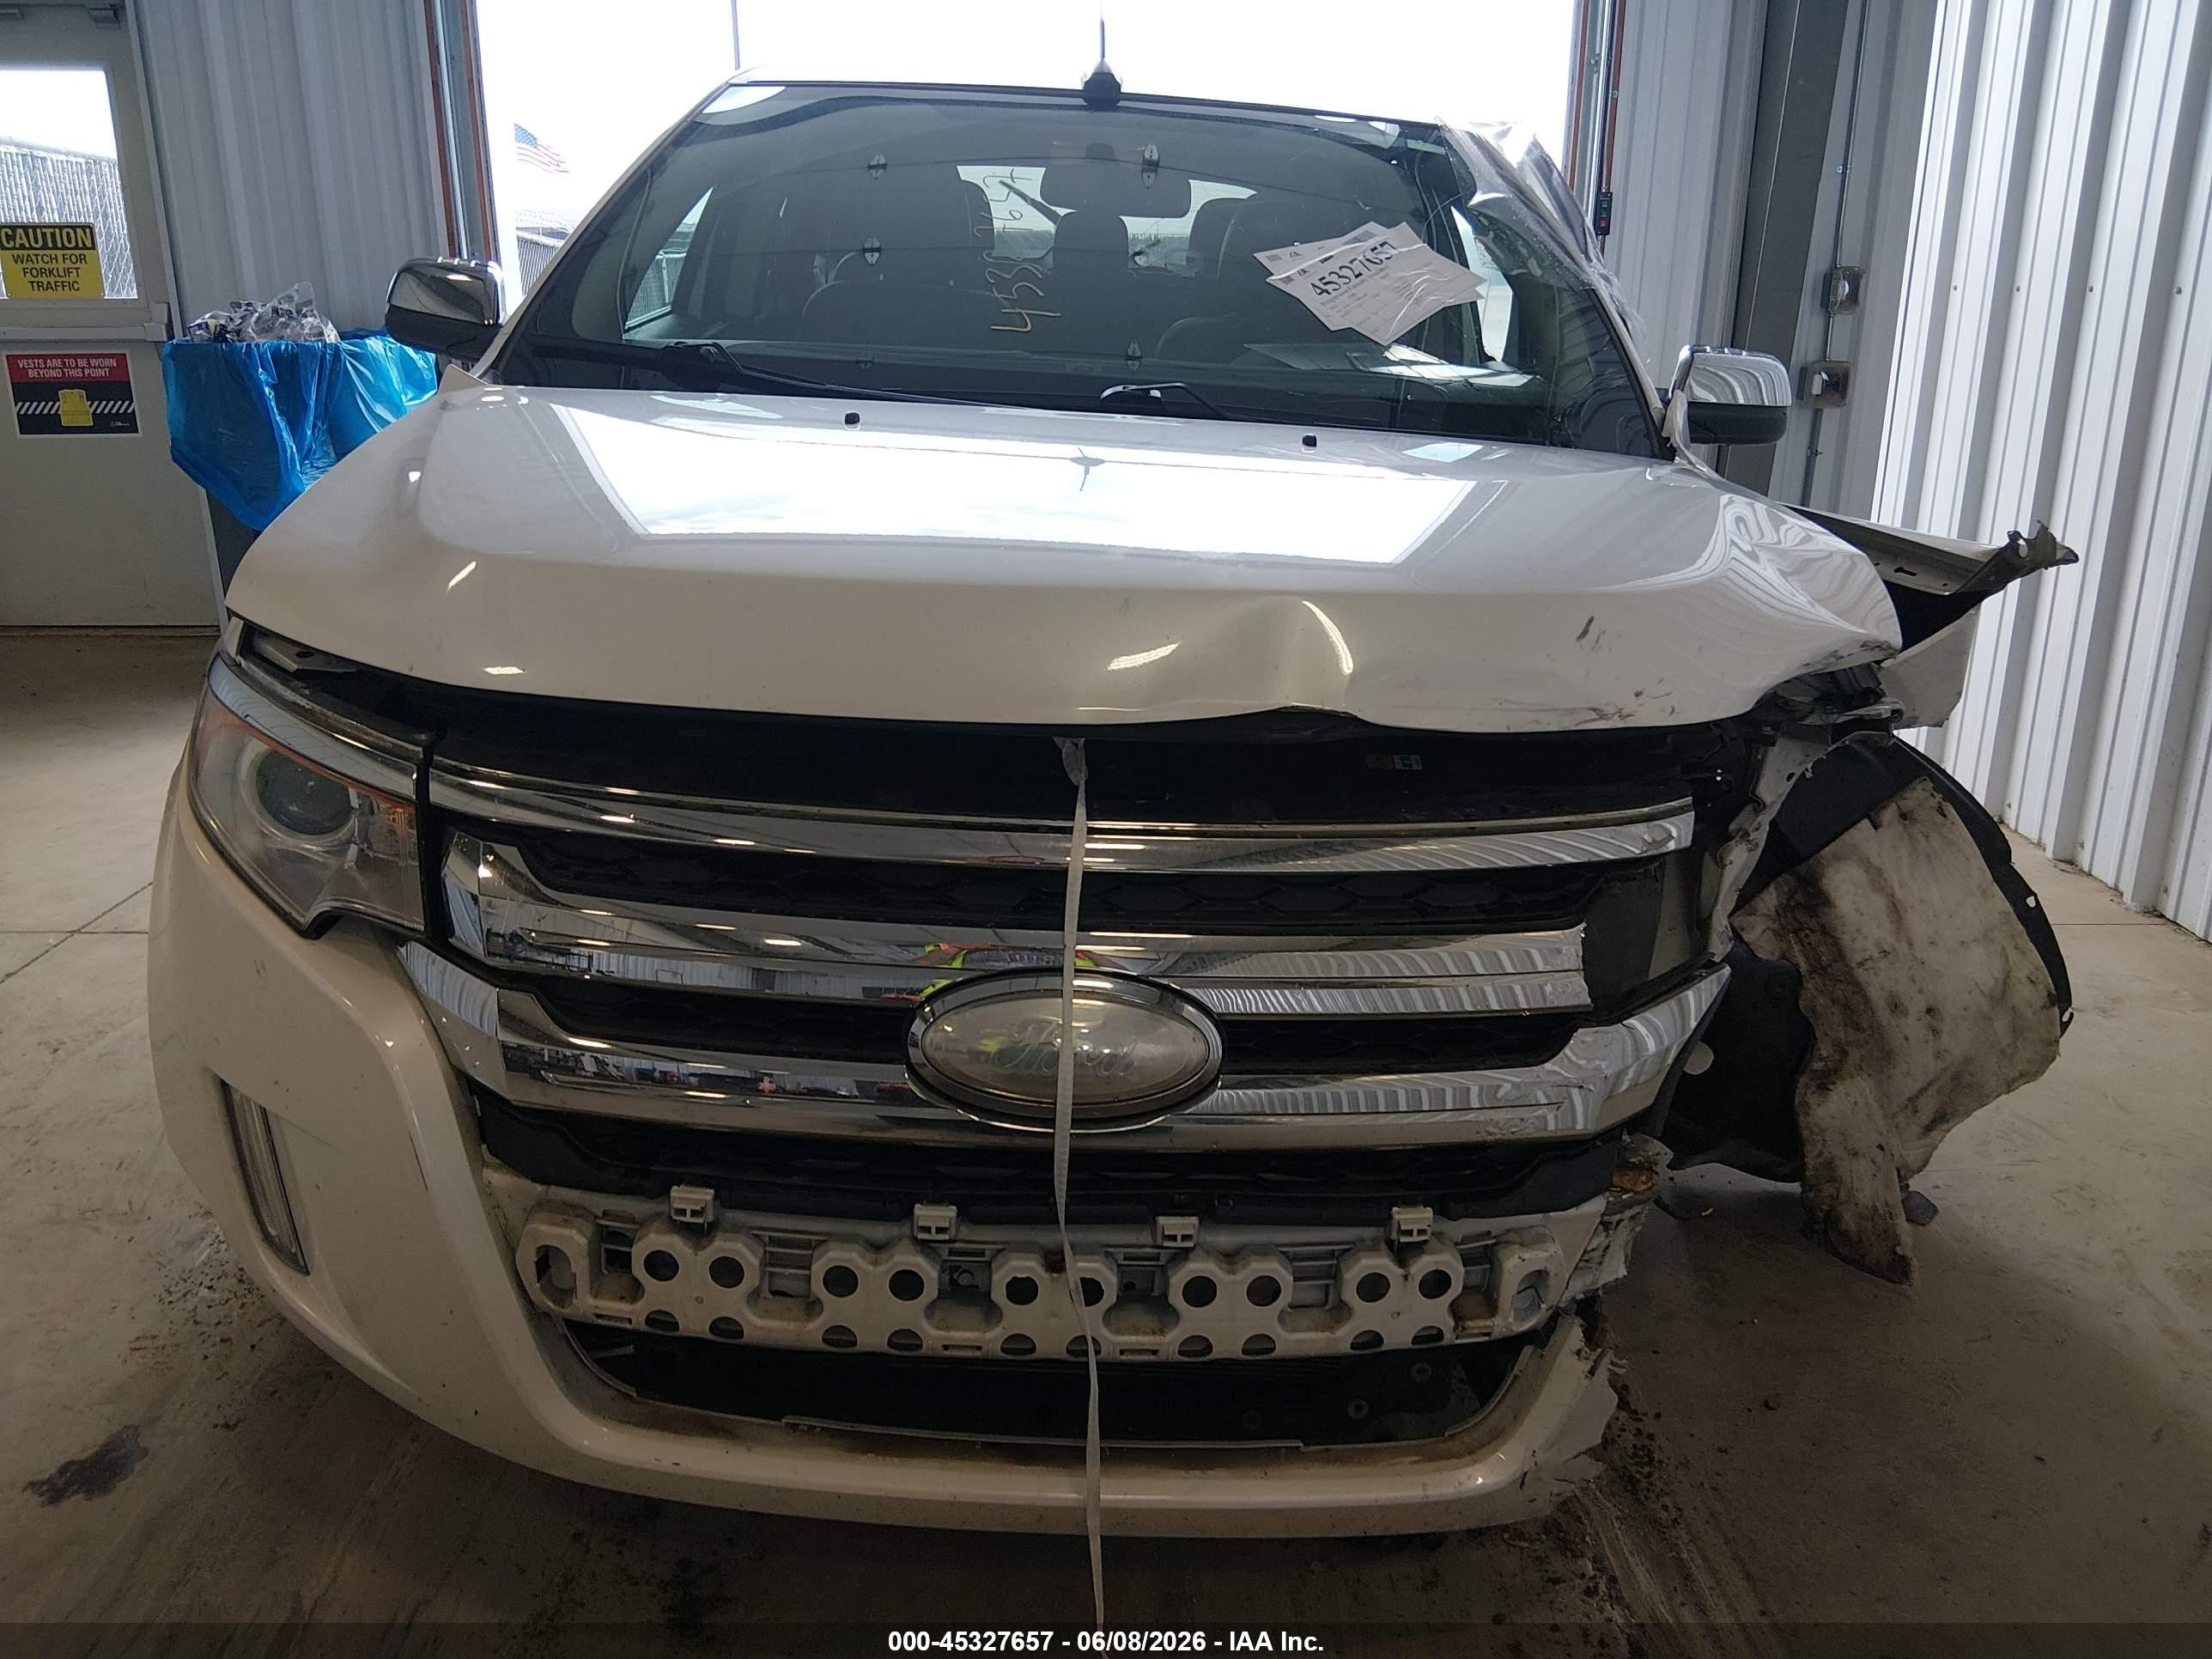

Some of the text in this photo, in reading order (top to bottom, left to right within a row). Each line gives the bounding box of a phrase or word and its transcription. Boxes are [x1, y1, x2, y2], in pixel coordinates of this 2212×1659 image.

[1, 228, 92, 249] CAUTION
[12, 253, 88, 265] WATCH FOR
[22, 267, 82, 278] FORKLIFT
[1310, 240, 1398, 296] 45327657
[28, 281, 81, 292] TRAFFIC
[17, 358, 118, 369] VESTS ARE TO BE WORN
[27, 368, 110, 379] BEYOND THIS POINT
